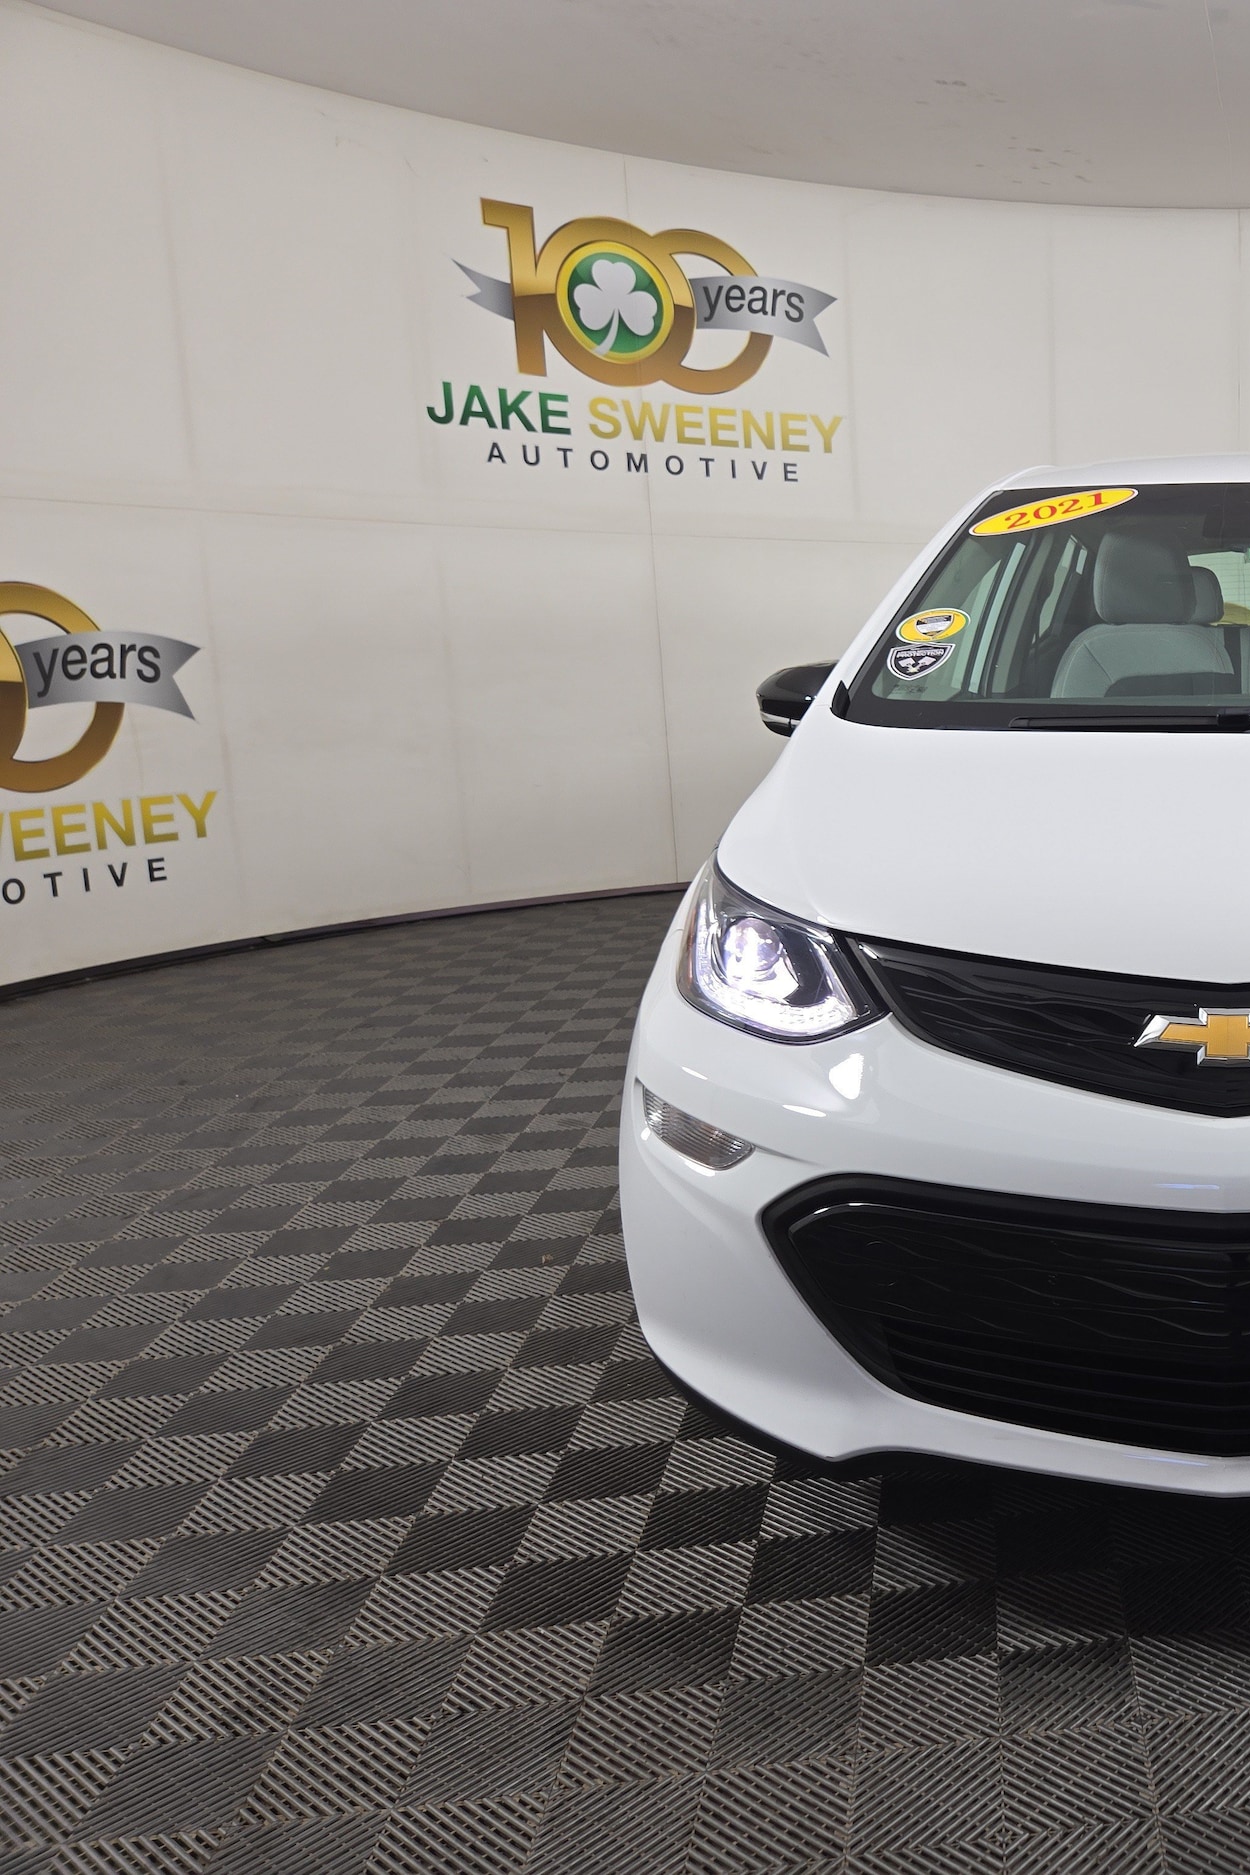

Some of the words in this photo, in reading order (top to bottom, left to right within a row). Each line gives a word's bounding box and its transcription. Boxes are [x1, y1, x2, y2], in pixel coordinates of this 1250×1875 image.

[480, 197, 774, 395] 100
[703, 283, 805, 322] years
[426, 381, 572, 436] JAKE
[588, 397, 844, 454] SWEENEY
[487, 442, 799, 482] AUTOMOTIVE
[1004, 492, 1108, 529] 2021
[32, 642, 161, 698] years
[0, 790, 218, 862] EENEY
